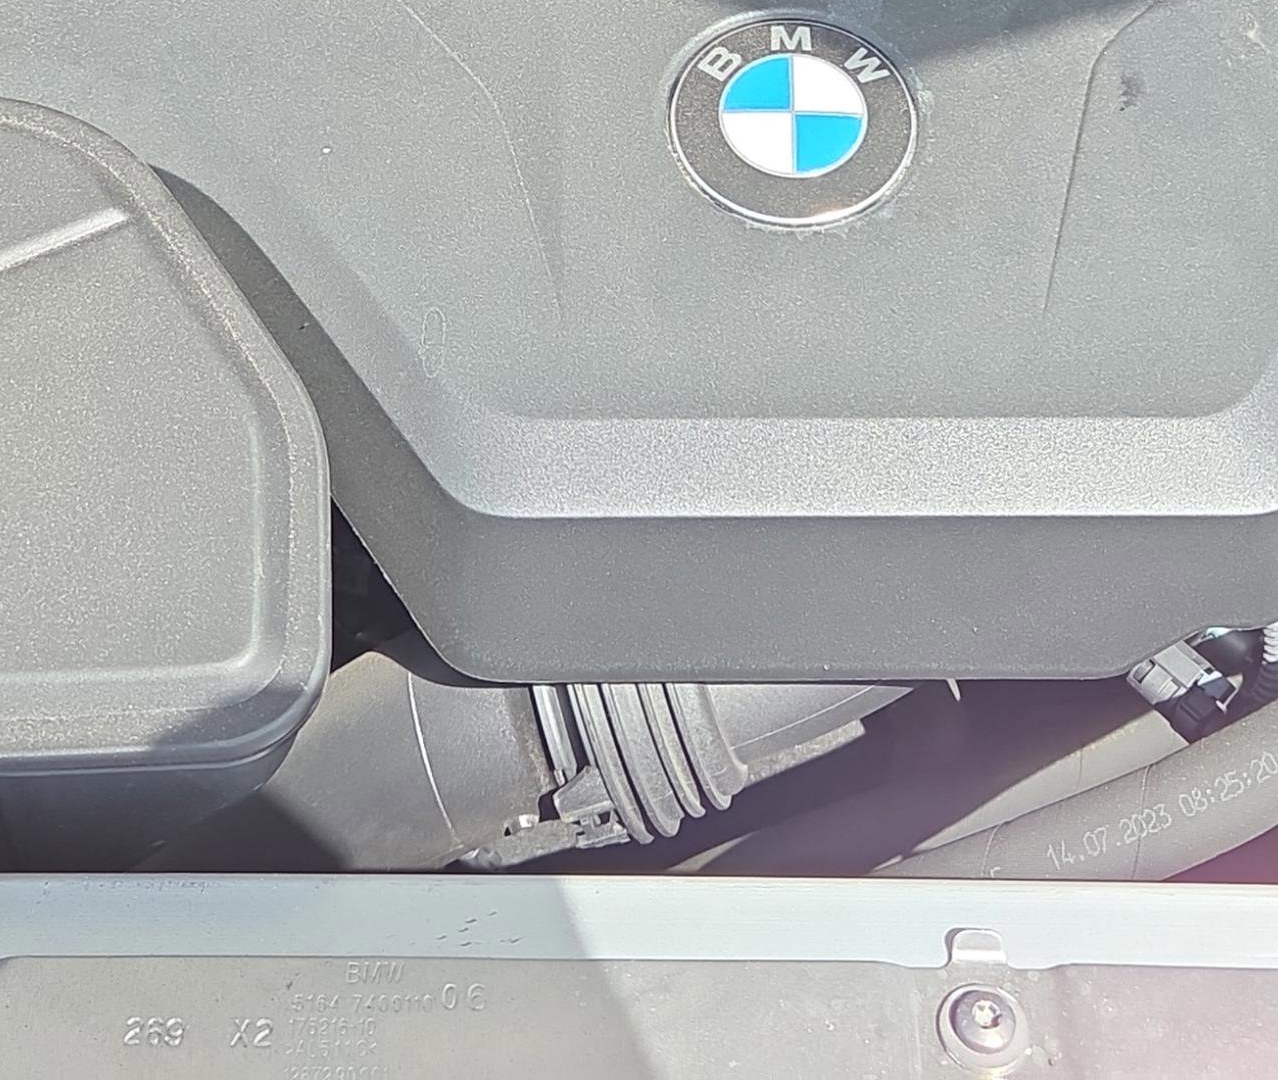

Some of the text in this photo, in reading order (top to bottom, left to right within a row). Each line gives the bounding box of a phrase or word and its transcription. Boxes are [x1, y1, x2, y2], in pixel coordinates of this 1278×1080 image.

[697, 24, 891, 84] BMW
[1046, 803, 1172, 871] 14.07.2023
[1178, 751, 1278, 817] 08:25:20
[345, 961, 406, 985] BMW
[123, 1016, 273, 1048] 269 X2
